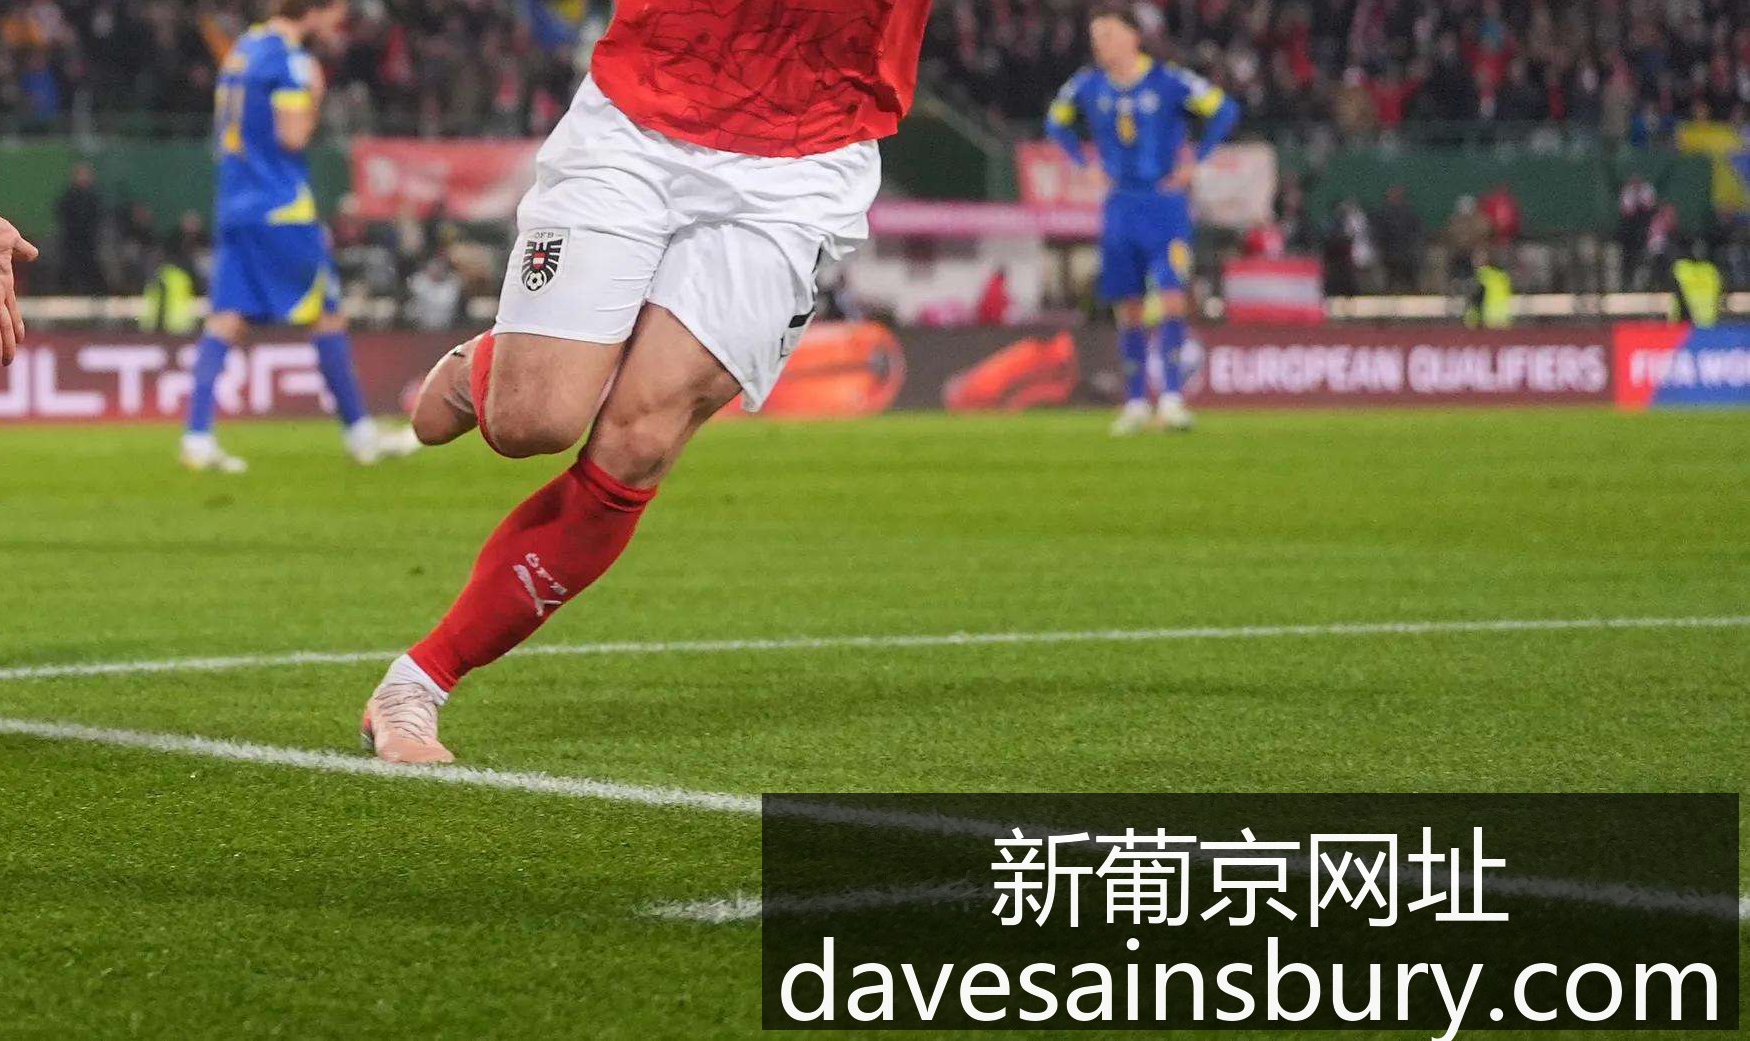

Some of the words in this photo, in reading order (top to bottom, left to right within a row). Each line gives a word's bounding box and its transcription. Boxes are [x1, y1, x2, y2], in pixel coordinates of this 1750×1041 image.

[1210, 345, 1403, 393] EUROPEAN
[1409, 345, 1609, 393] QUALIFIERS
[1630, 349, 1695, 388] FIFA
